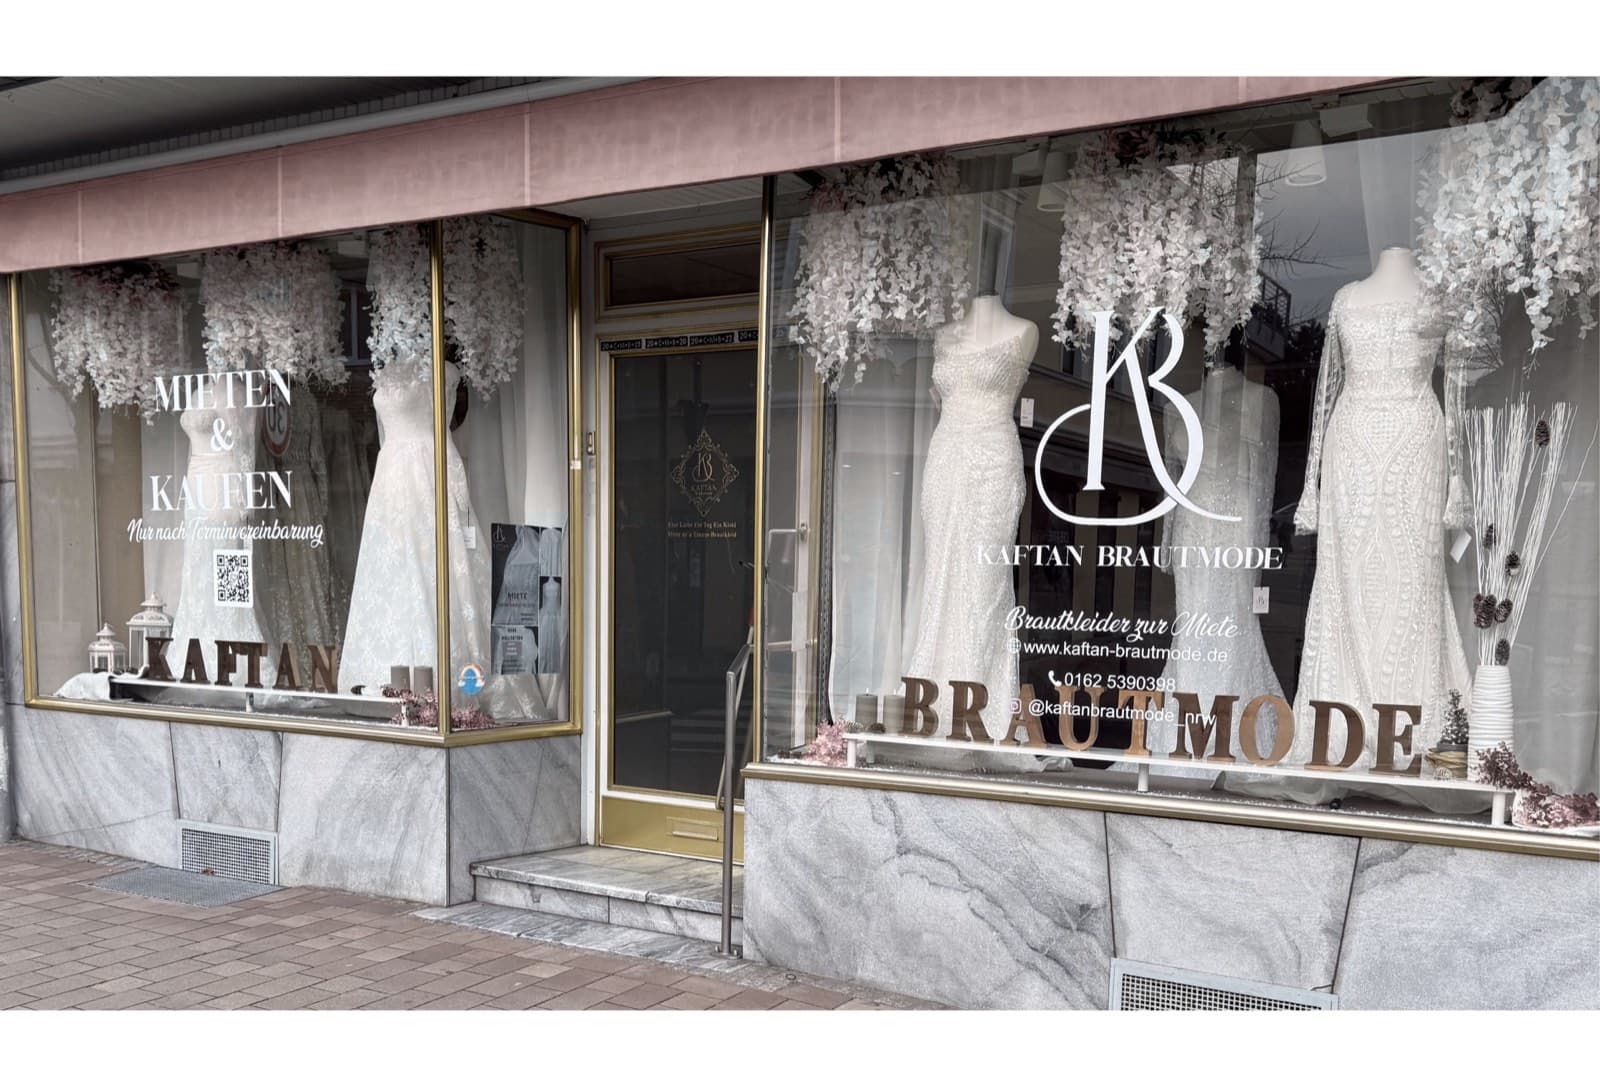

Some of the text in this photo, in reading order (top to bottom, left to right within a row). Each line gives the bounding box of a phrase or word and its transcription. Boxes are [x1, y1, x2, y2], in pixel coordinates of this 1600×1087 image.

[154, 369, 292, 412] MIETEN
[210, 418, 234, 452] &
[150, 471, 293, 511] KAUFEN
[127, 516, 324, 549] Nur nach Terminvereinbarung
[977, 545, 1283, 570] KAFTAN BRAUTMODE
[1004, 606, 1239, 641] Brautkleider zur Miete
[145, 637, 338, 694] KAFTAN
[1024, 641, 1228, 663] www.kaftan-brautmode.de
[1064, 672, 1176, 692] 0162 5390398
[900, 676, 1423, 778] BRAUTMODE
[1028, 698, 1216, 727] @kaftanbrautmode_nrw
